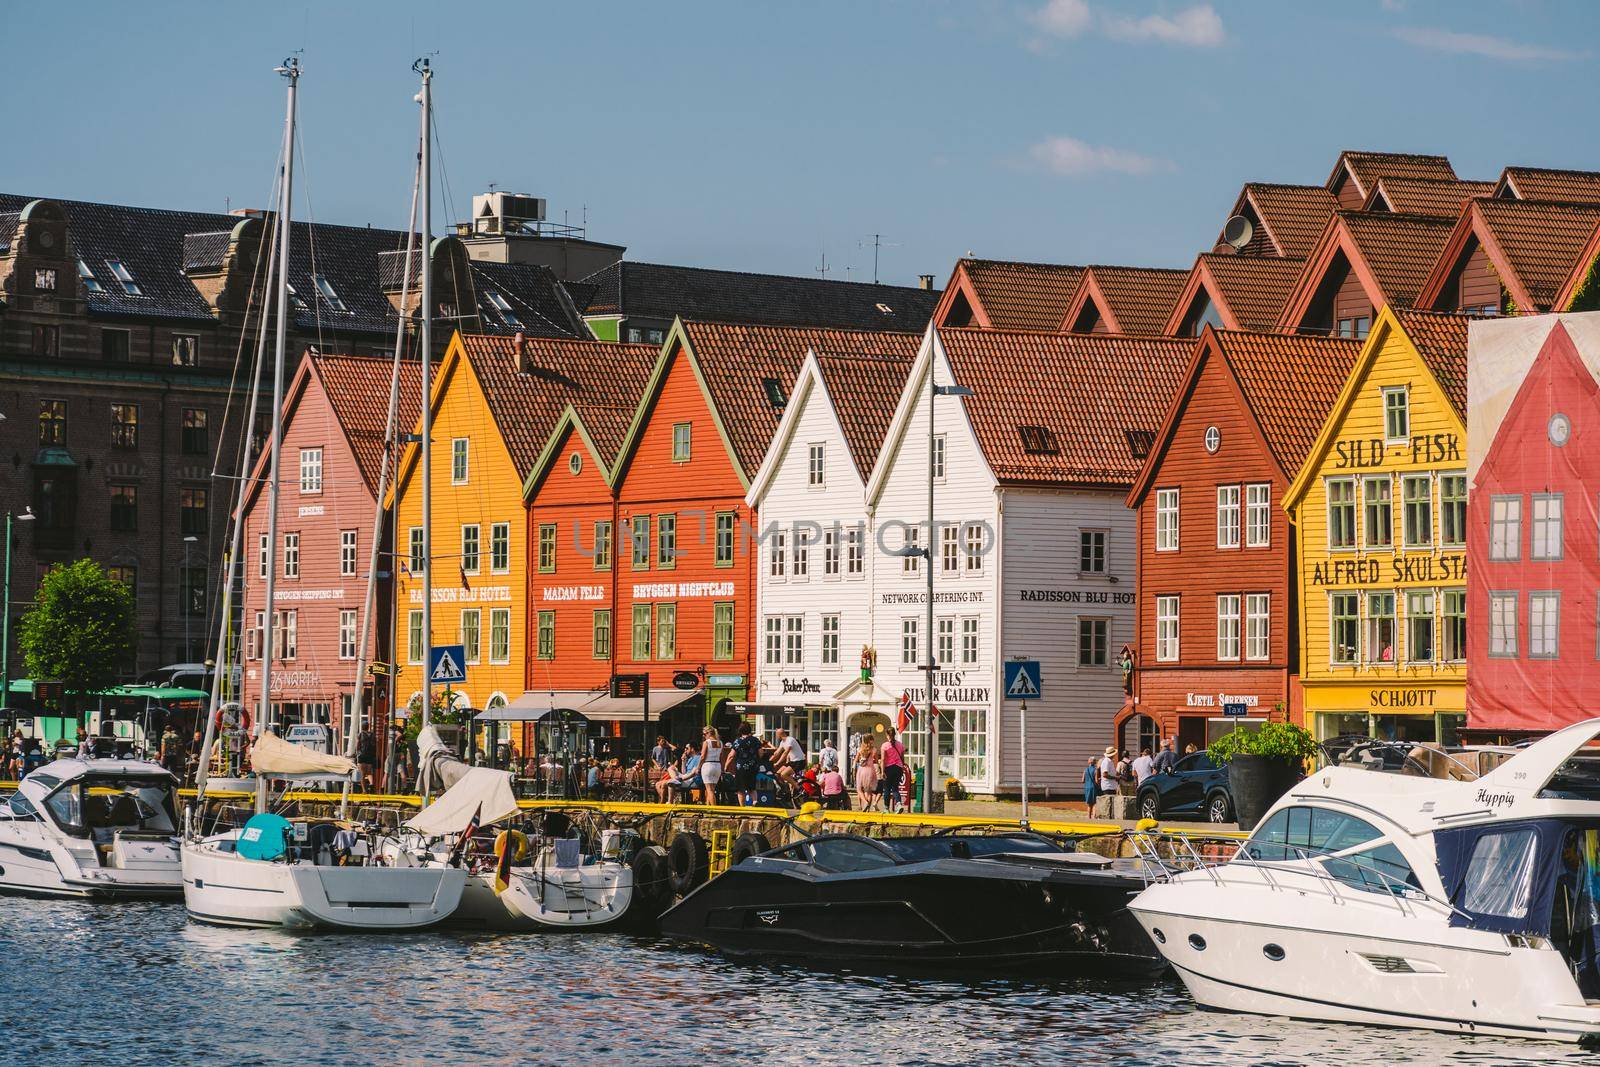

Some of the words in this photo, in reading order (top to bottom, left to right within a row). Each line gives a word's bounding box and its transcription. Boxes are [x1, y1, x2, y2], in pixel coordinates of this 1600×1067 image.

[1336, 439, 1384, 468] SILD
[1412, 433, 1460, 464] FISK
[1313, 559, 1380, 585] ALFRED
[460, 587, 477, 602] BLU
[480, 586, 512, 601] HOTEL
[543, 587, 578, 600] MADAM
[580, 586, 604, 600] FELLE
[633, 584, 677, 598] BRYGGEN
[679, 582, 735, 597] NIGHTCLUB
[882, 593, 919, 604] NETWORK
[920, 592, 968, 603] CARTERING
[1020, 590, 1081, 602] RADISSON
[1086, 592, 1108, 603] BLU
[904, 688, 940, 702] SILVR
[945, 688, 991, 702] GALLERY
[1370, 689, 1437, 707] SCHJØTT
[1228, 705, 1245, 714] Taxi
[1475, 788, 1515, 808] Hyppig
